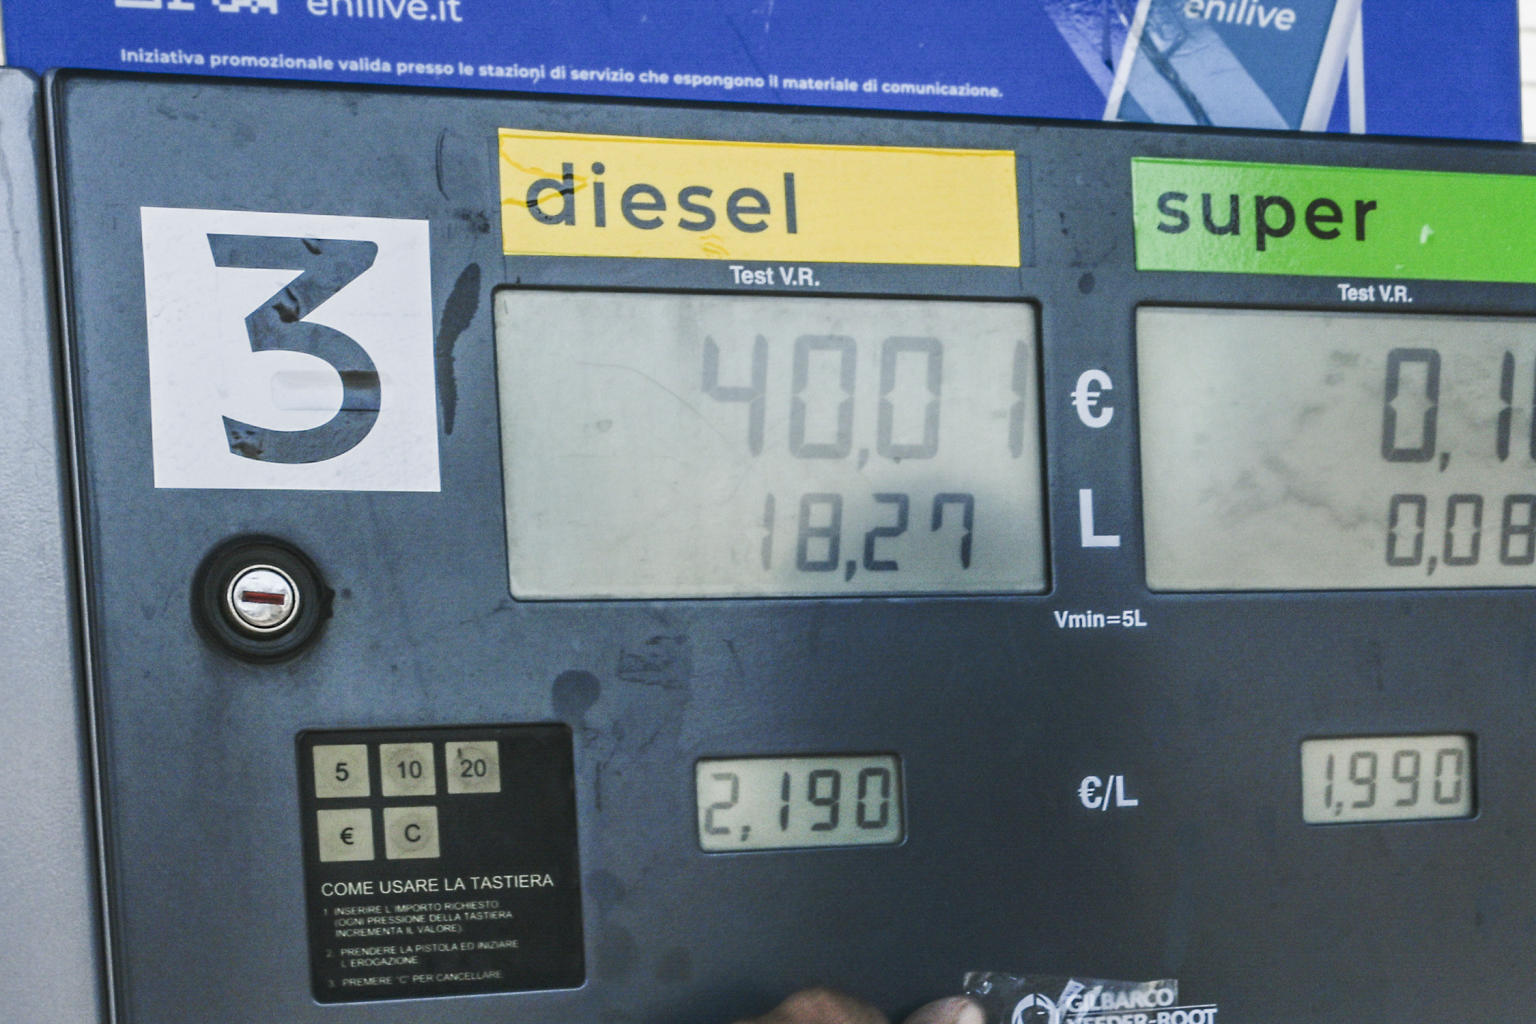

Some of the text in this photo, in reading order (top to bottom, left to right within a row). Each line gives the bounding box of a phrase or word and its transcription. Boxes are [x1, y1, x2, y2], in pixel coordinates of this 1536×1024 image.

[1183, 0, 1296, 31] enilive
[120, 48, 1004, 98] Iniziativa promozionale valida presso le stazioni di servizio che espongono il materiale di comunicazione.
[525, 160, 799, 235] diesel
[1156, 187, 1379, 251] super
[729, 266, 820, 287] Test V.R.
[1337, 283, 1413, 303] Test V.R.
[207, 233, 381, 464] 3
[1071, 369, 1115, 428] €
[1079, 489, 1120, 547] L
[761, 493, 975, 582] 18,27
[1054, 609, 1148, 629] Vmin=5L
[335, 762, 349, 782] 5
[397, 760, 423, 779] 10
[460, 759, 487, 777] 20
[1324, 748, 1464, 816] 1,990
[704, 767, 890, 842] 2,190
[1077, 775, 1139, 811] €/L
[340, 826, 354, 846] €
[404, 823, 421, 842] C
[321, 873, 554, 897] COME USARE LA TASTIERA
